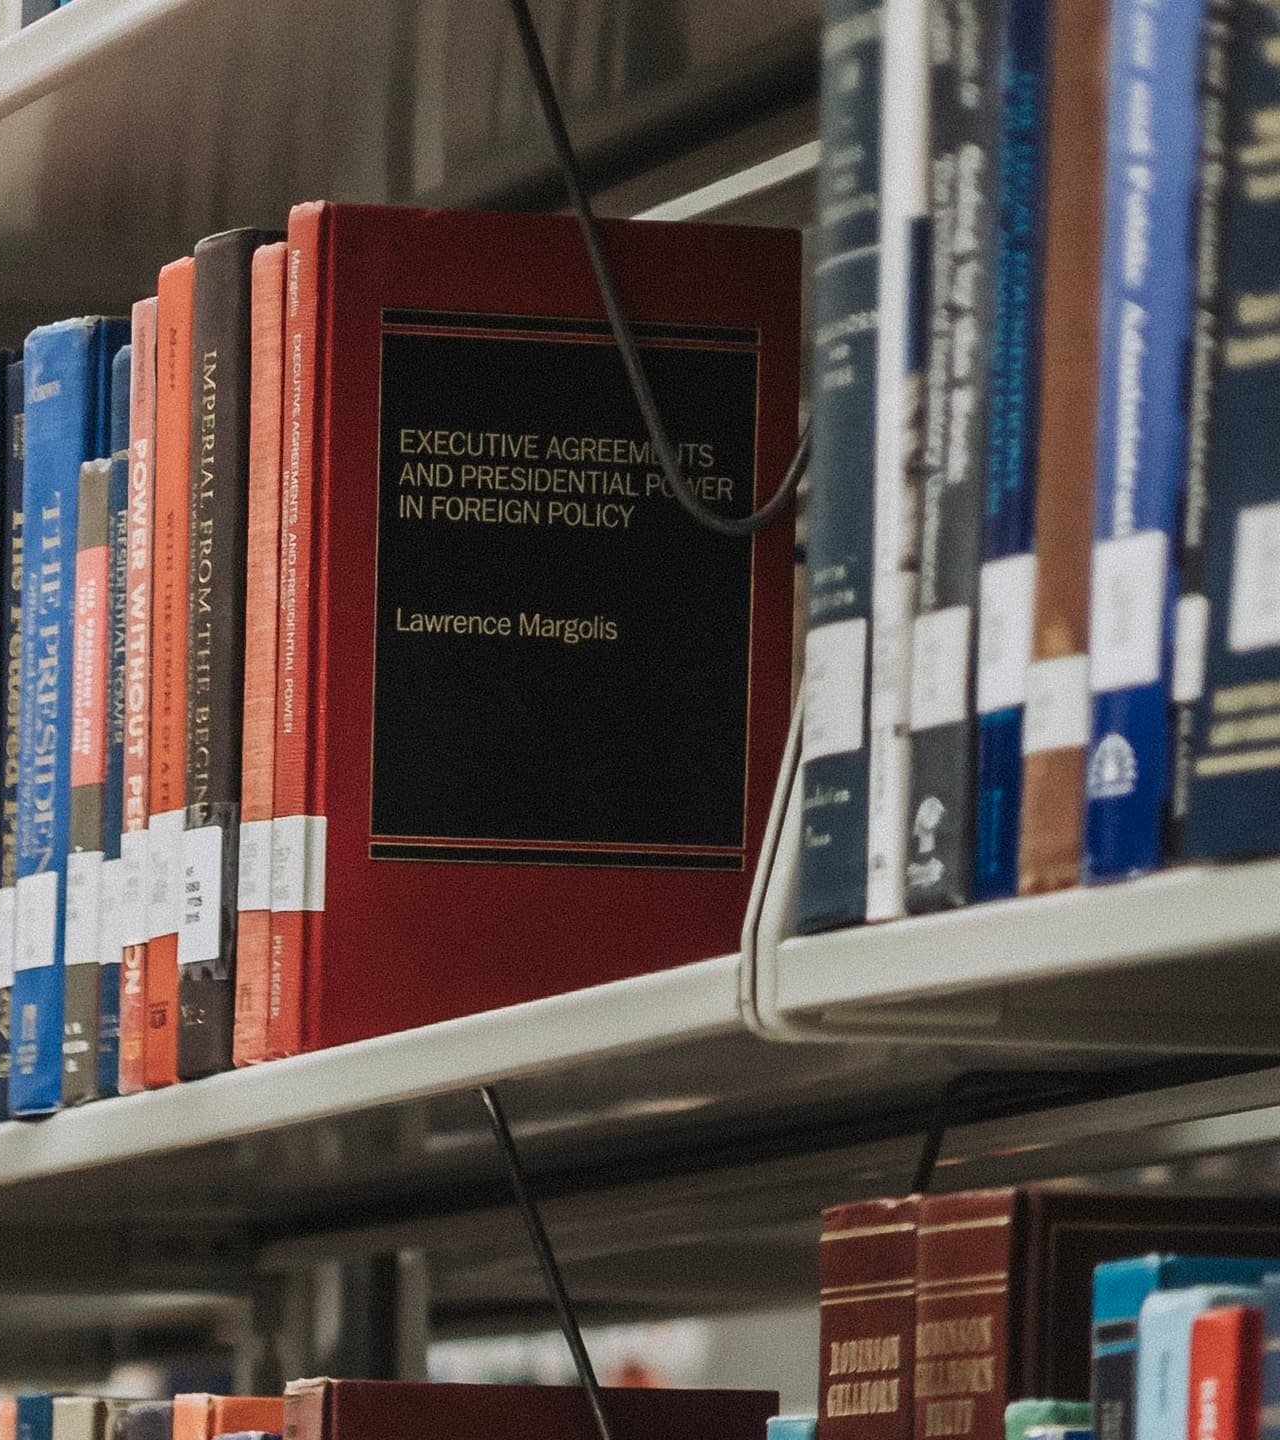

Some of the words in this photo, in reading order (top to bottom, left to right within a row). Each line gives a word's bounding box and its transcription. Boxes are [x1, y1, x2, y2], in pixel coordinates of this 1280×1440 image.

[291, 333, 302, 417] EXECUTIVE
[199, 349, 219, 501] IMPERIAL
[399, 428, 539, 460] EXECUTIVE
[130, 437, 149, 570] POWER
[288, 420, 302, 525] AGREEMENTS
[399, 462, 453, 488] AND
[460, 464, 640, 498] PRESIDENTIAL
[399, 494, 424, 520] IN
[431, 496, 540, 525] FOREIGN
[547, 501, 635, 529] POLICY
[38, 490, 62, 615] THE
[113, 509, 128, 661] PRESIDENTIAL
[197, 518, 215, 613] FROM
[287, 532, 298, 566] AND
[195, 623, 212, 695] THE
[285, 567, 298, 673] PRESIDENTIAL
[395, 606, 512, 637] Lawrence
[518, 611, 618, 644] Margolis
[112, 667, 126, 744] POWER
[127, 582, 148, 759] WITHOUT
[283, 677, 294, 734] POWER
[33, 622, 60, 875] PRESIDEN
